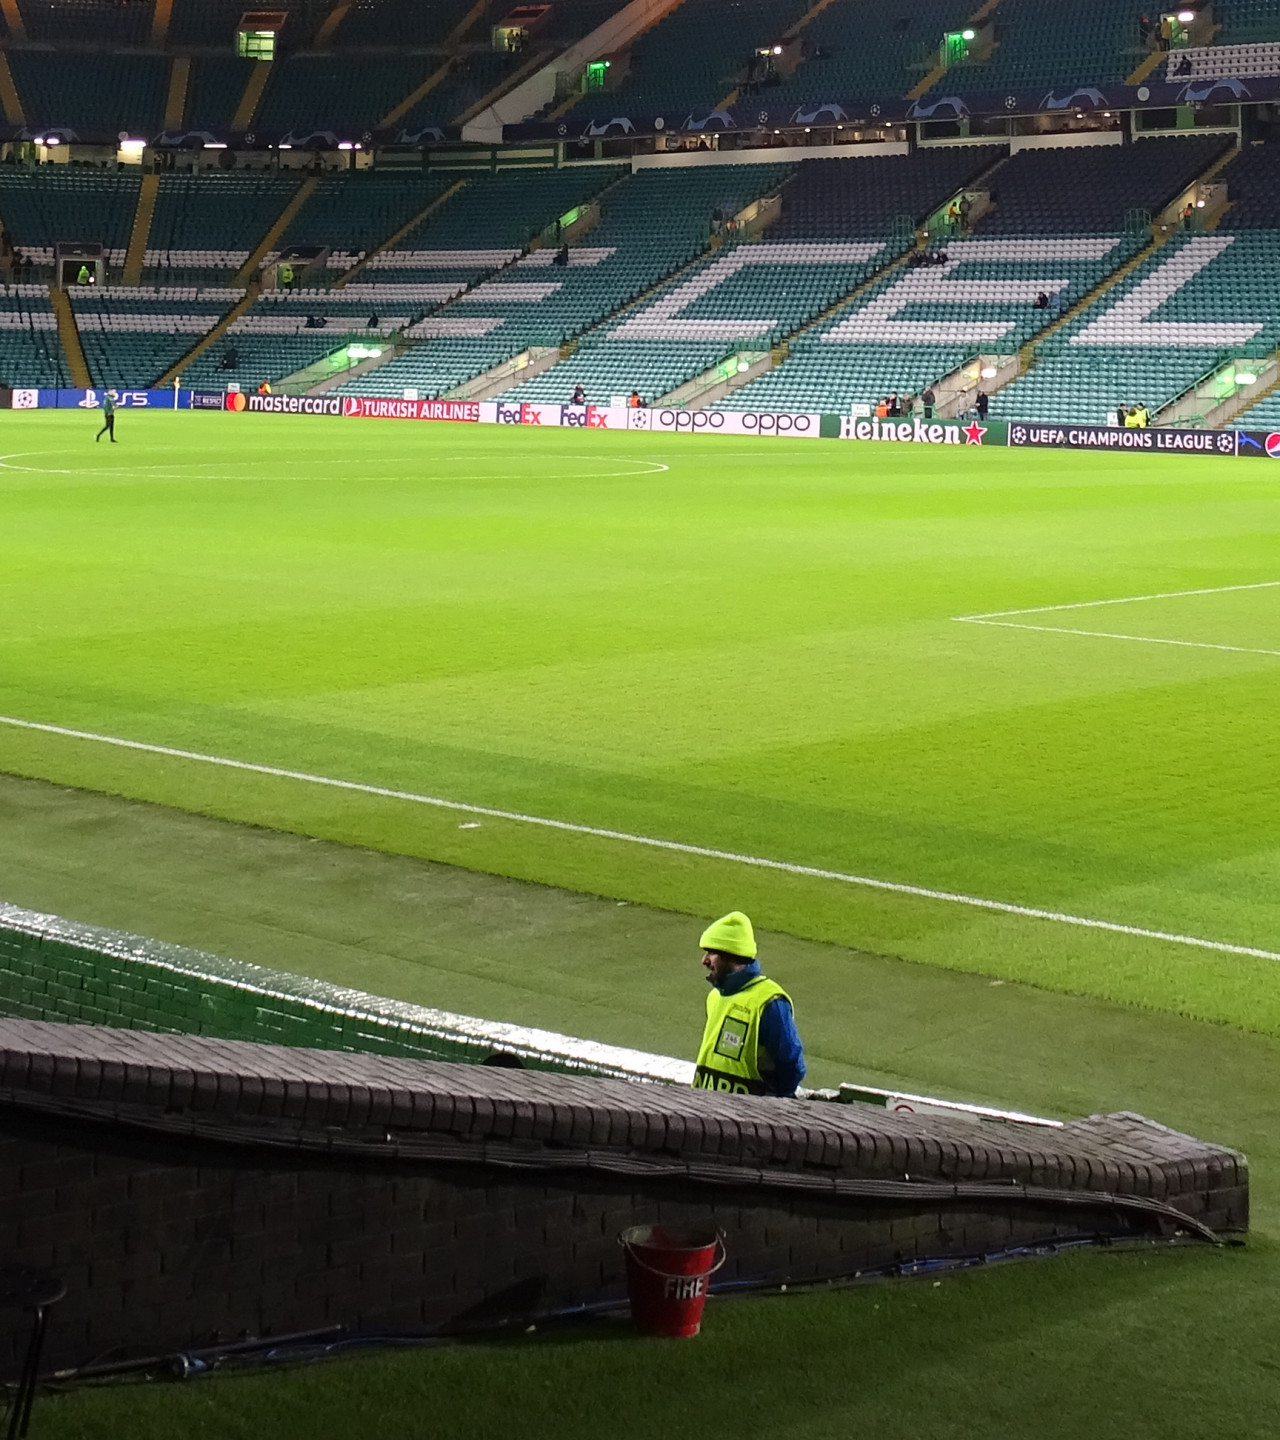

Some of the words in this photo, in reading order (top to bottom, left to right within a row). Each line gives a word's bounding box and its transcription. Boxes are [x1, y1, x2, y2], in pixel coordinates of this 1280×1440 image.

[249, 396, 340, 414] mastercard
[364, 401, 417, 418] TURKISH
[421, 403, 480, 422] AIRLINES
[497, 402, 542, 425] FedEx
[561, 405, 608, 428] FedEx
[660, 410, 725, 432] oppo
[742, 413, 811, 436] oppo
[839, 416, 961, 444] Heineken
[1029, 429, 1066, 444] UEFA
[1069, 430, 1152, 447] CHAMPIONS
[1157, 433, 1213, 449] LEAGUE
[664, 1275, 704, 1300] FIRE
